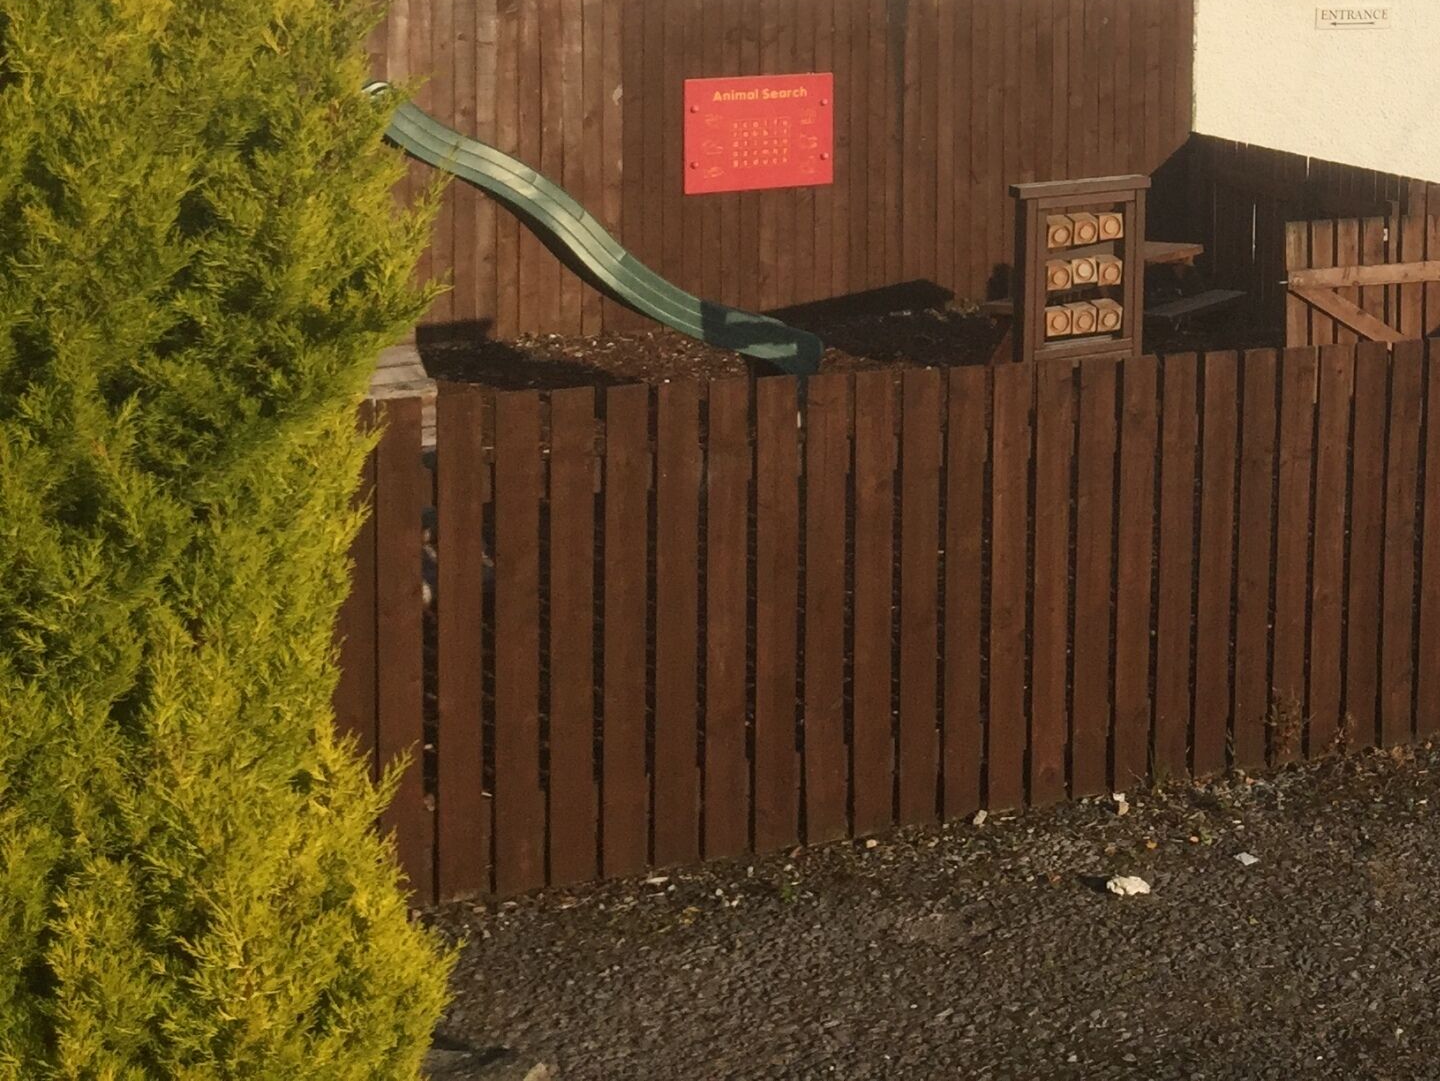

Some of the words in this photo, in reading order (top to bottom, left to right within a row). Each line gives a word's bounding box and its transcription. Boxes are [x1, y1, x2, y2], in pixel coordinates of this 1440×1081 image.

[1321, 8, 1388, 21] ENTRANCE
[712, 88, 759, 102] Animal
[762, 86, 808, 100] Search
